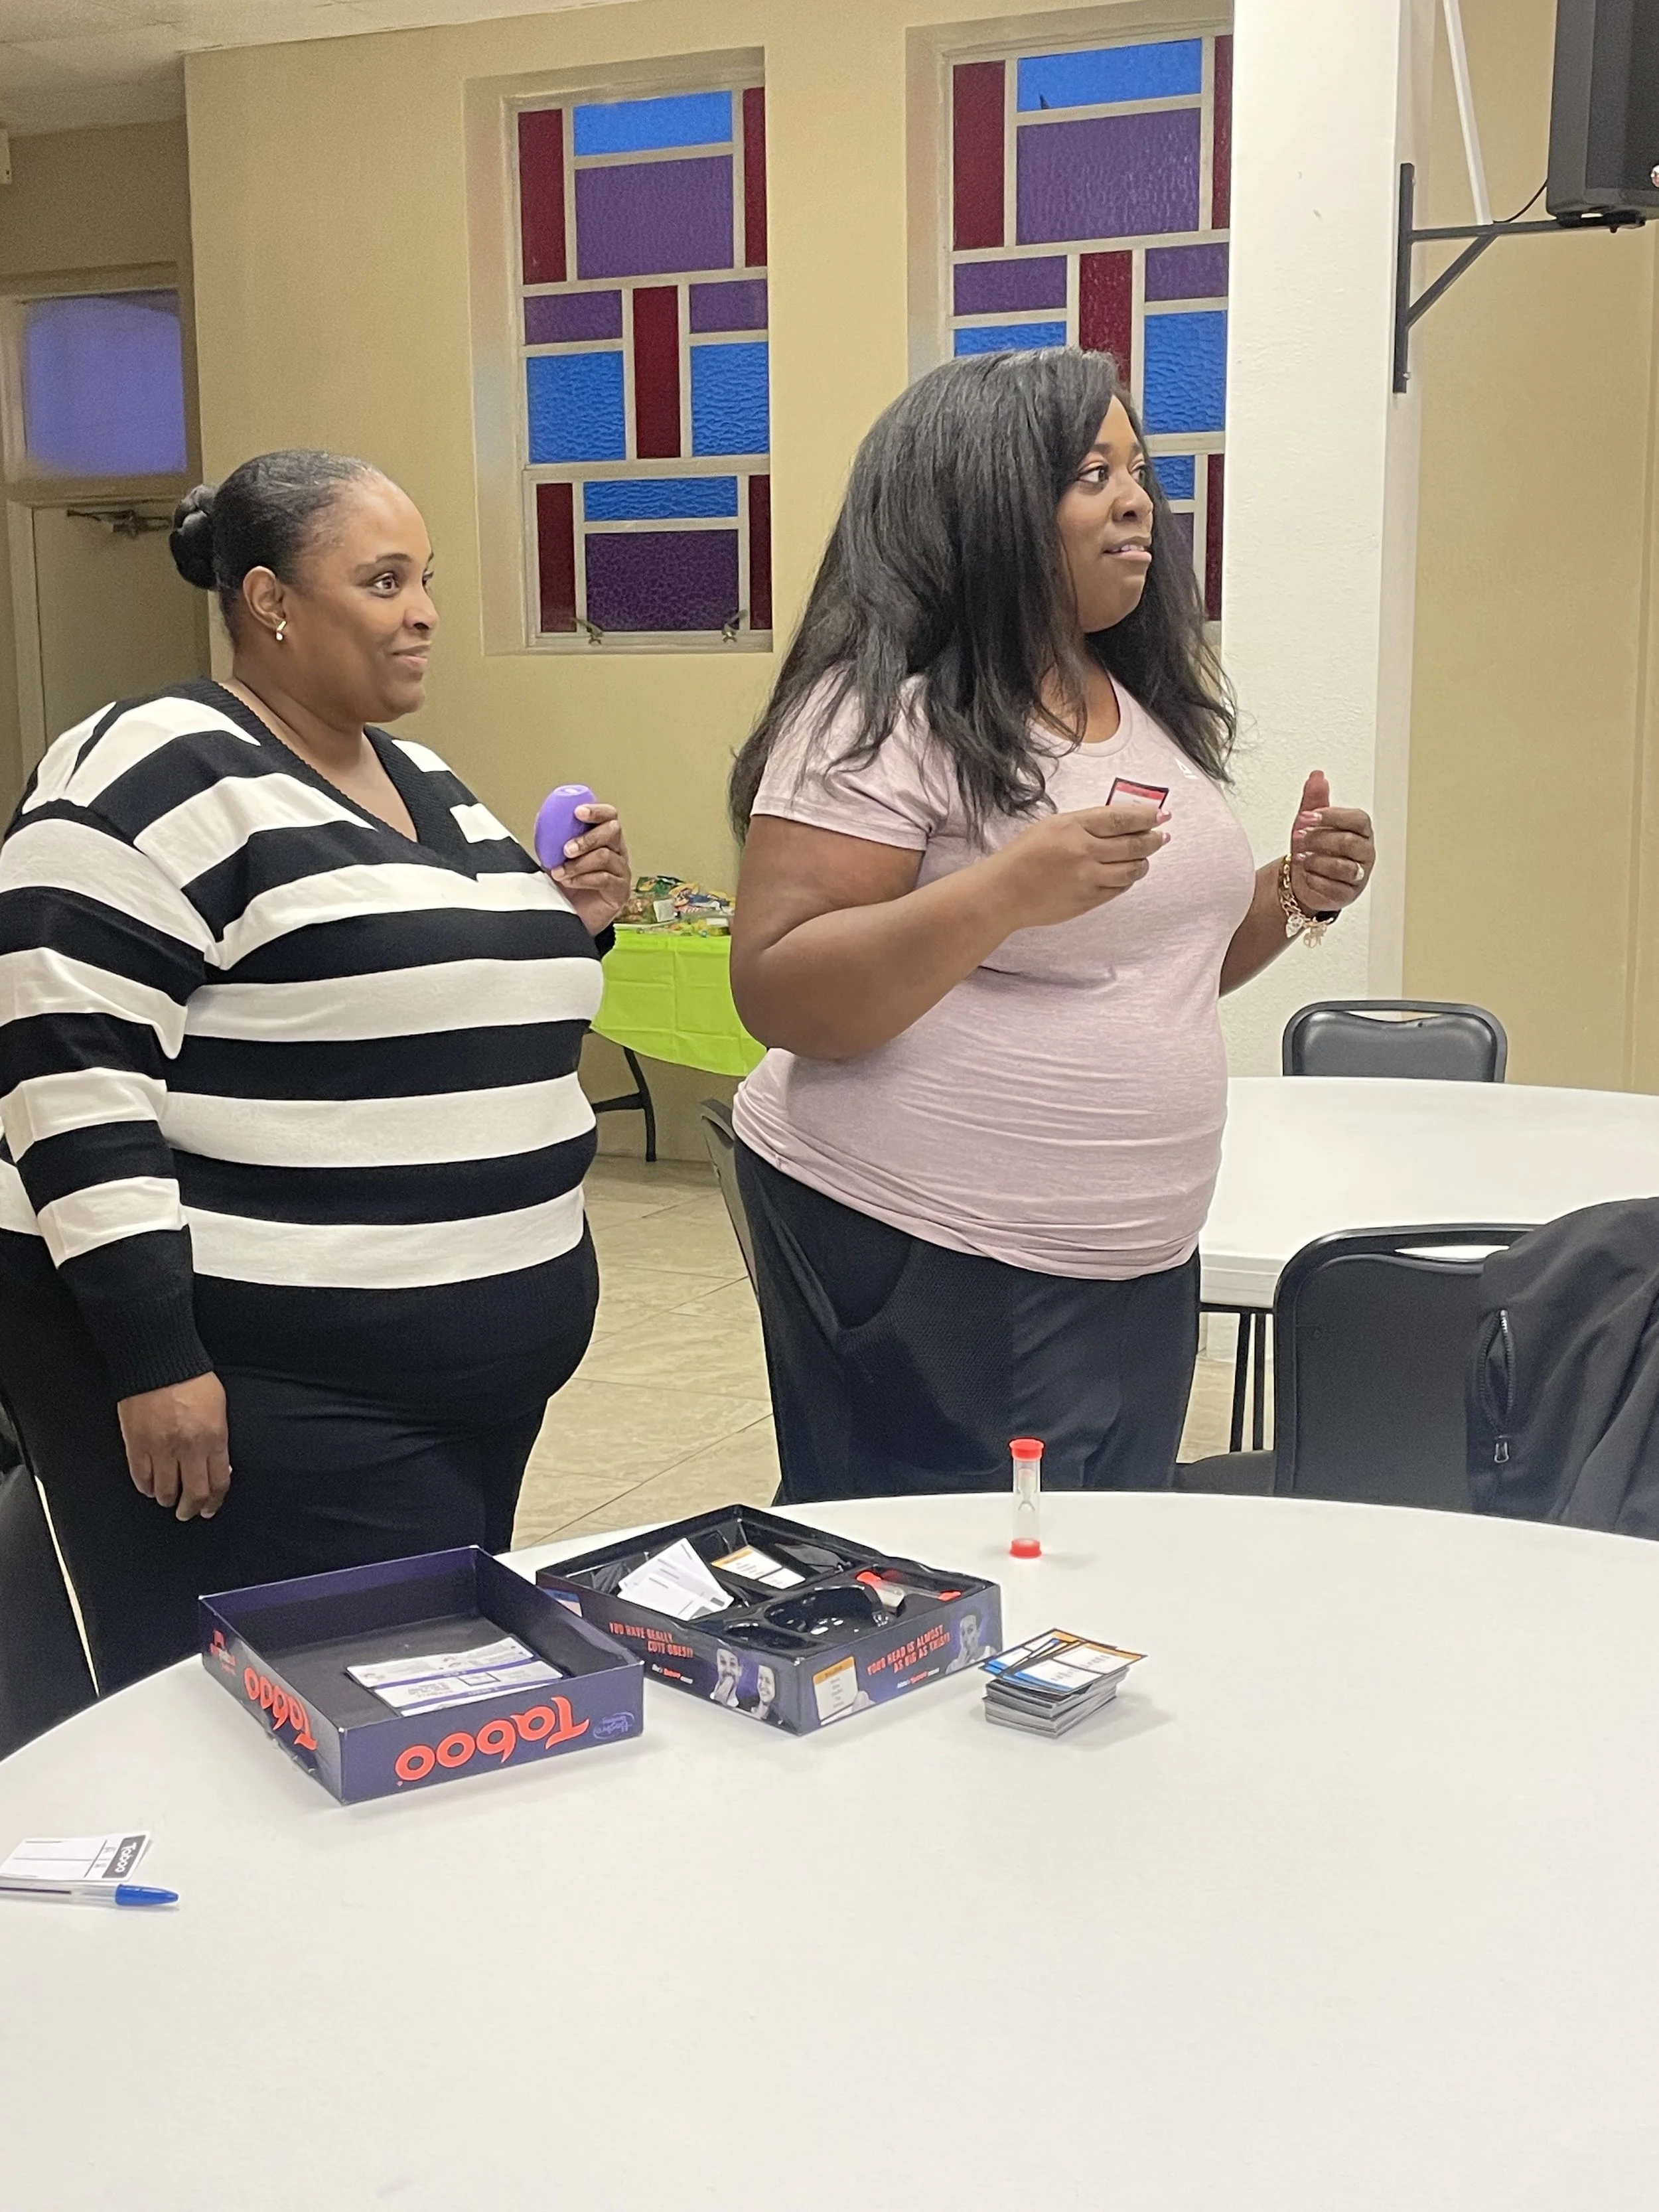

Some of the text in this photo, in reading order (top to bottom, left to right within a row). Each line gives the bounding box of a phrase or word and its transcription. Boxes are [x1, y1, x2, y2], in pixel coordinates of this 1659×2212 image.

[887, 1646, 906, 1664] HEAD
[906, 1641, 916, 1653] IS
[917, 1624, 944, 1647] ALMOST
[894, 1659, 904, 1674] AS
[918, 1645, 928, 1659] AS
[243, 1666, 318, 1751] Taboo
[394, 1695, 590, 1781] Taboo
[115, 1842, 137, 1873] Taboo
